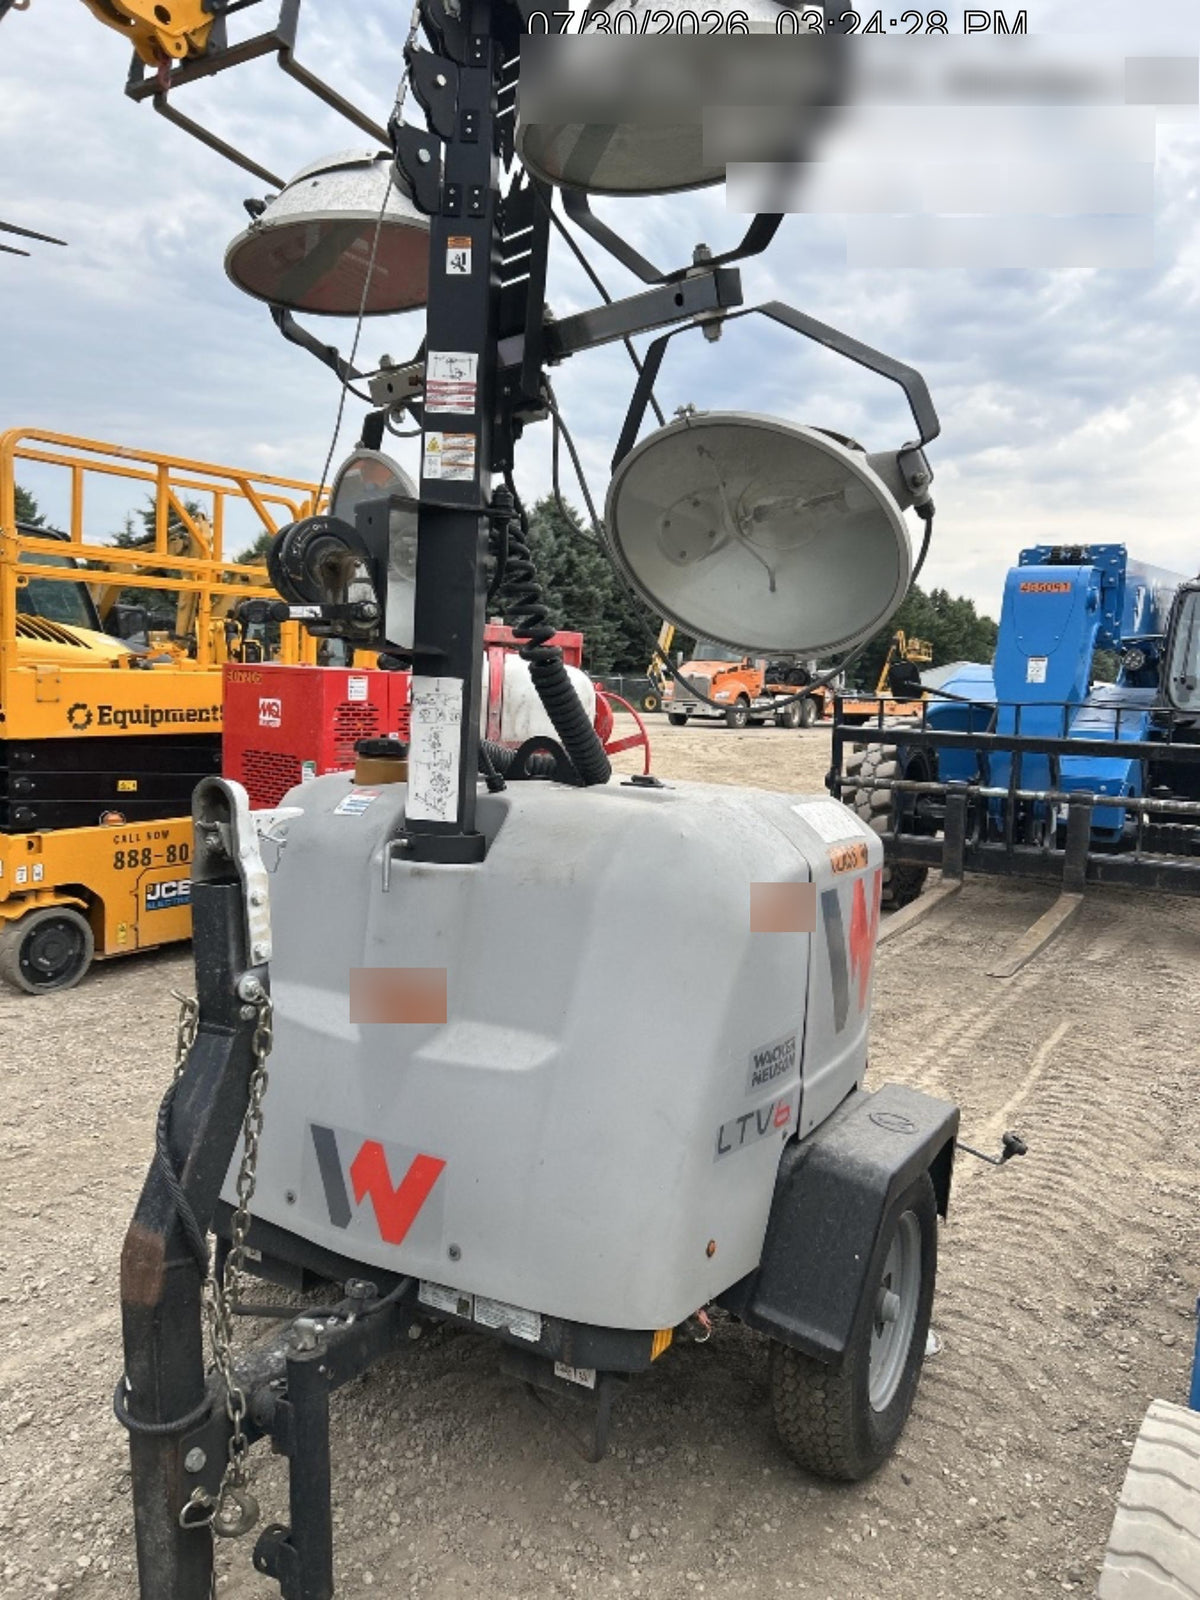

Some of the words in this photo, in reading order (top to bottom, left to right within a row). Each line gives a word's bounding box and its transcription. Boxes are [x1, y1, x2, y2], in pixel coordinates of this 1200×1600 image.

[113, 833, 141, 844] CALL
[113, 843, 189, 869] 888-80
[751, 1051, 796, 1087] NEUSON
[753, 1036, 796, 1069] WACKER
[718, 1098, 791, 1154] LTV6
